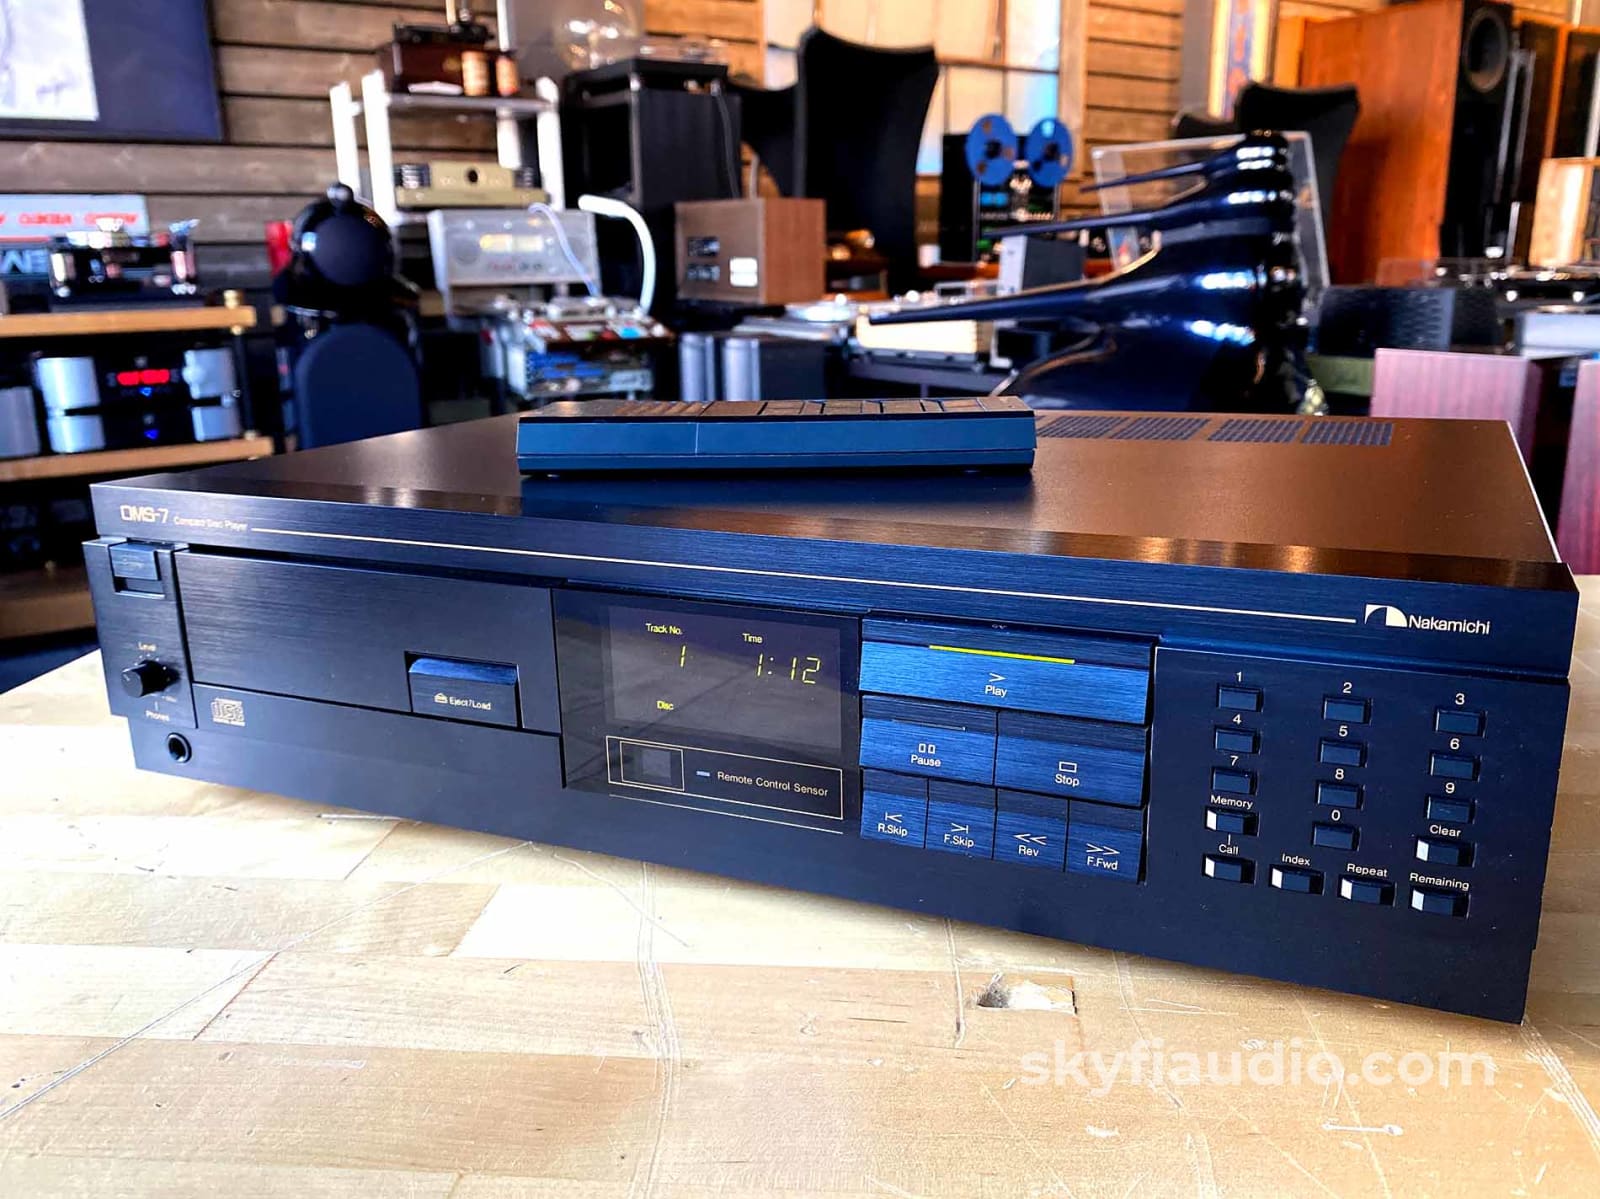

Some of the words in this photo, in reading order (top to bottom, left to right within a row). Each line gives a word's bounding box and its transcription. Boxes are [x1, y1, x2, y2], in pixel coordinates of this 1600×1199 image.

[120, 504, 168, 524] OMS-7
[645, 622, 667, 634] Track
[669, 624, 683, 635] No.
[1408, 614, 1490, 635] Nakamichi
[742, 632, 763, 644] Time
[679, 645, 686, 668] 1
[1236, 671, 1242, 682] 1
[985, 685, 1008, 698] Play
[1342, 682, 1352, 694] 2
[656, 699, 674, 711] Disc
[1455, 692, 1466, 705] 3
[1232, 713, 1242, 725] 4
[1338, 725, 1349, 737] 5
[1449, 737, 1460, 750] 6
[910, 754, 941, 768] Pause
[1230, 755, 1239, 766] 7
[1055, 773, 1080, 788] Stop
[1334, 768, 1345, 780] 8
[717, 770, 752, 786] Remote
[756, 776, 791, 792] Control
[793, 782, 829, 797] Sensor
[1445, 782, 1456, 794] 9
[1210, 794, 1253, 810] Memory
[877, 822, 908, 838] R.Skip
[1429, 824, 1462, 838] Clear
[944, 833, 975, 849] F.Skip
[1018, 844, 1040, 858] Rev
[1218, 843, 1239, 856] Call
[1087, 855, 1119, 871] F.Fwd
[1281, 853, 1311, 867] Index
[1347, 862, 1388, 878] Repeat
[1409, 871, 1470, 892] Remaining
